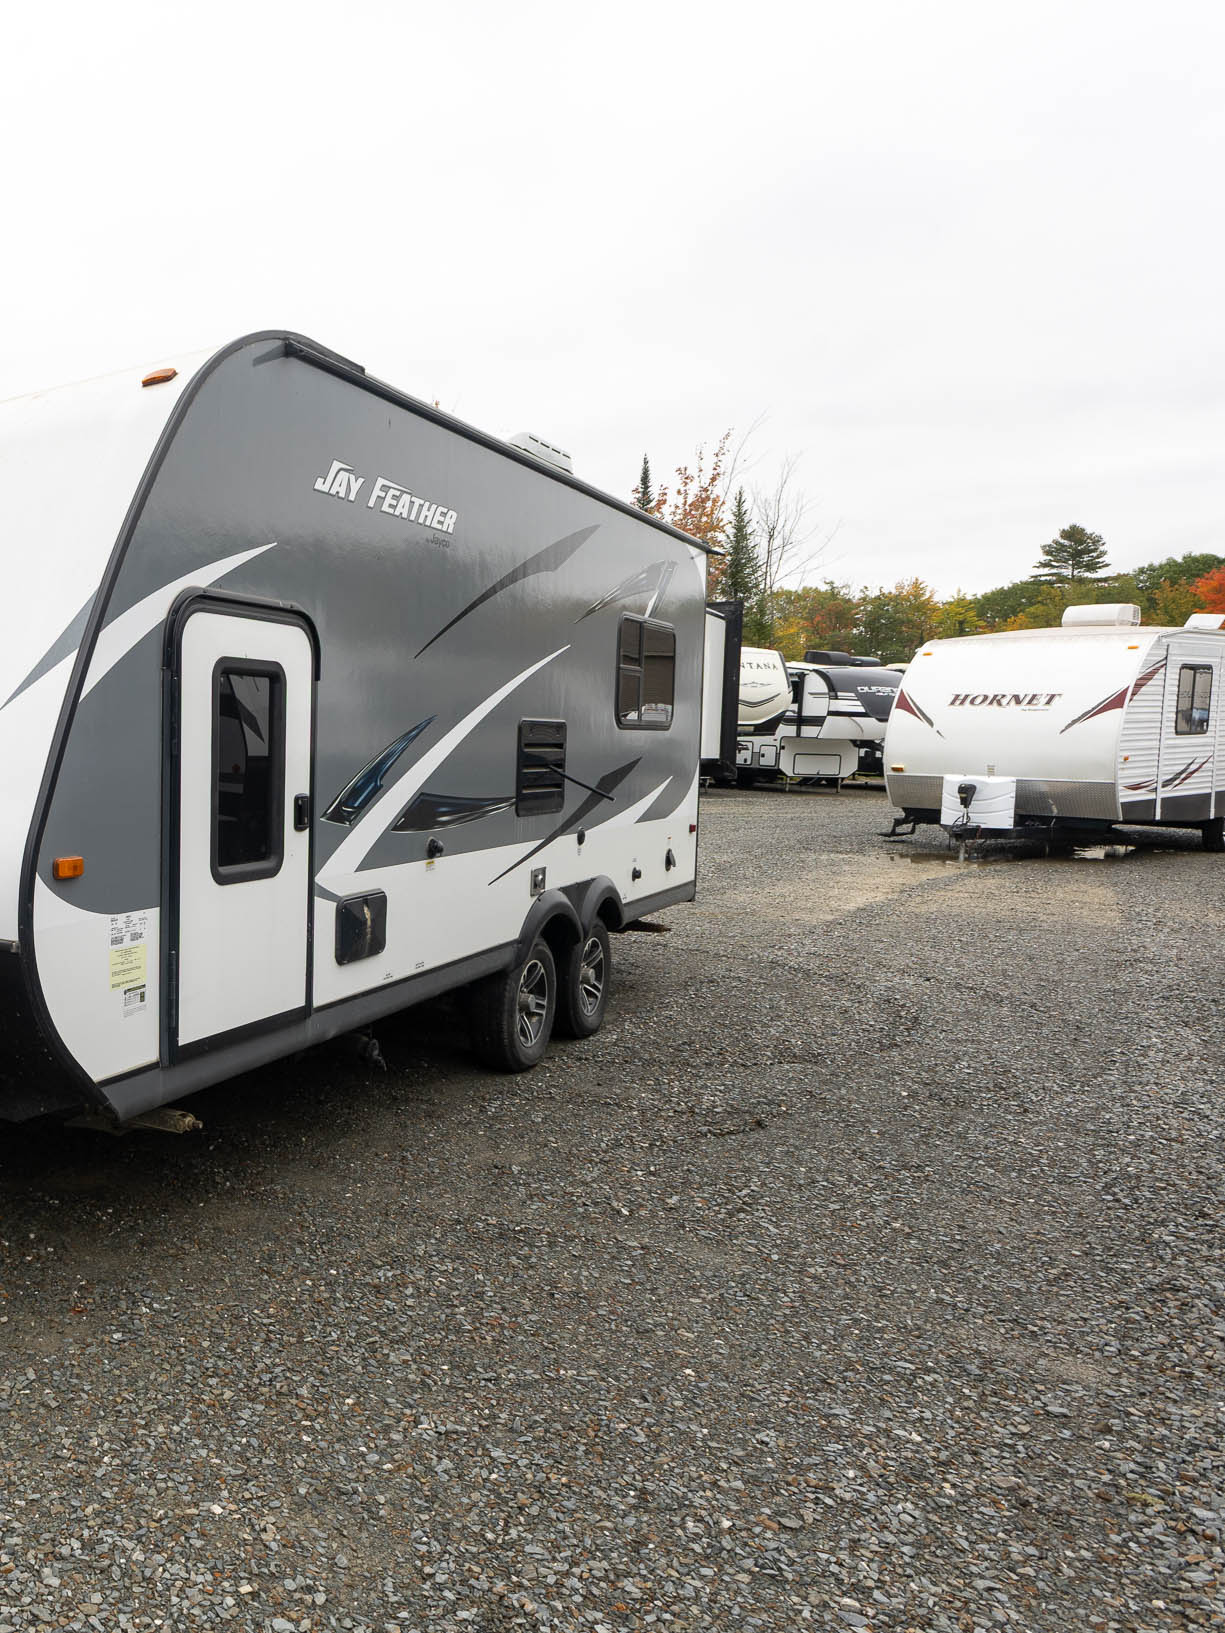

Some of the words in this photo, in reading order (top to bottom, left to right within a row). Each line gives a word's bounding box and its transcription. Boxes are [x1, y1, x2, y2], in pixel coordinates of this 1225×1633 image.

[313, 459, 366, 503] JAY
[367, 476, 458, 535] FEATHER
[947, 693, 1063, 709] HORNET
